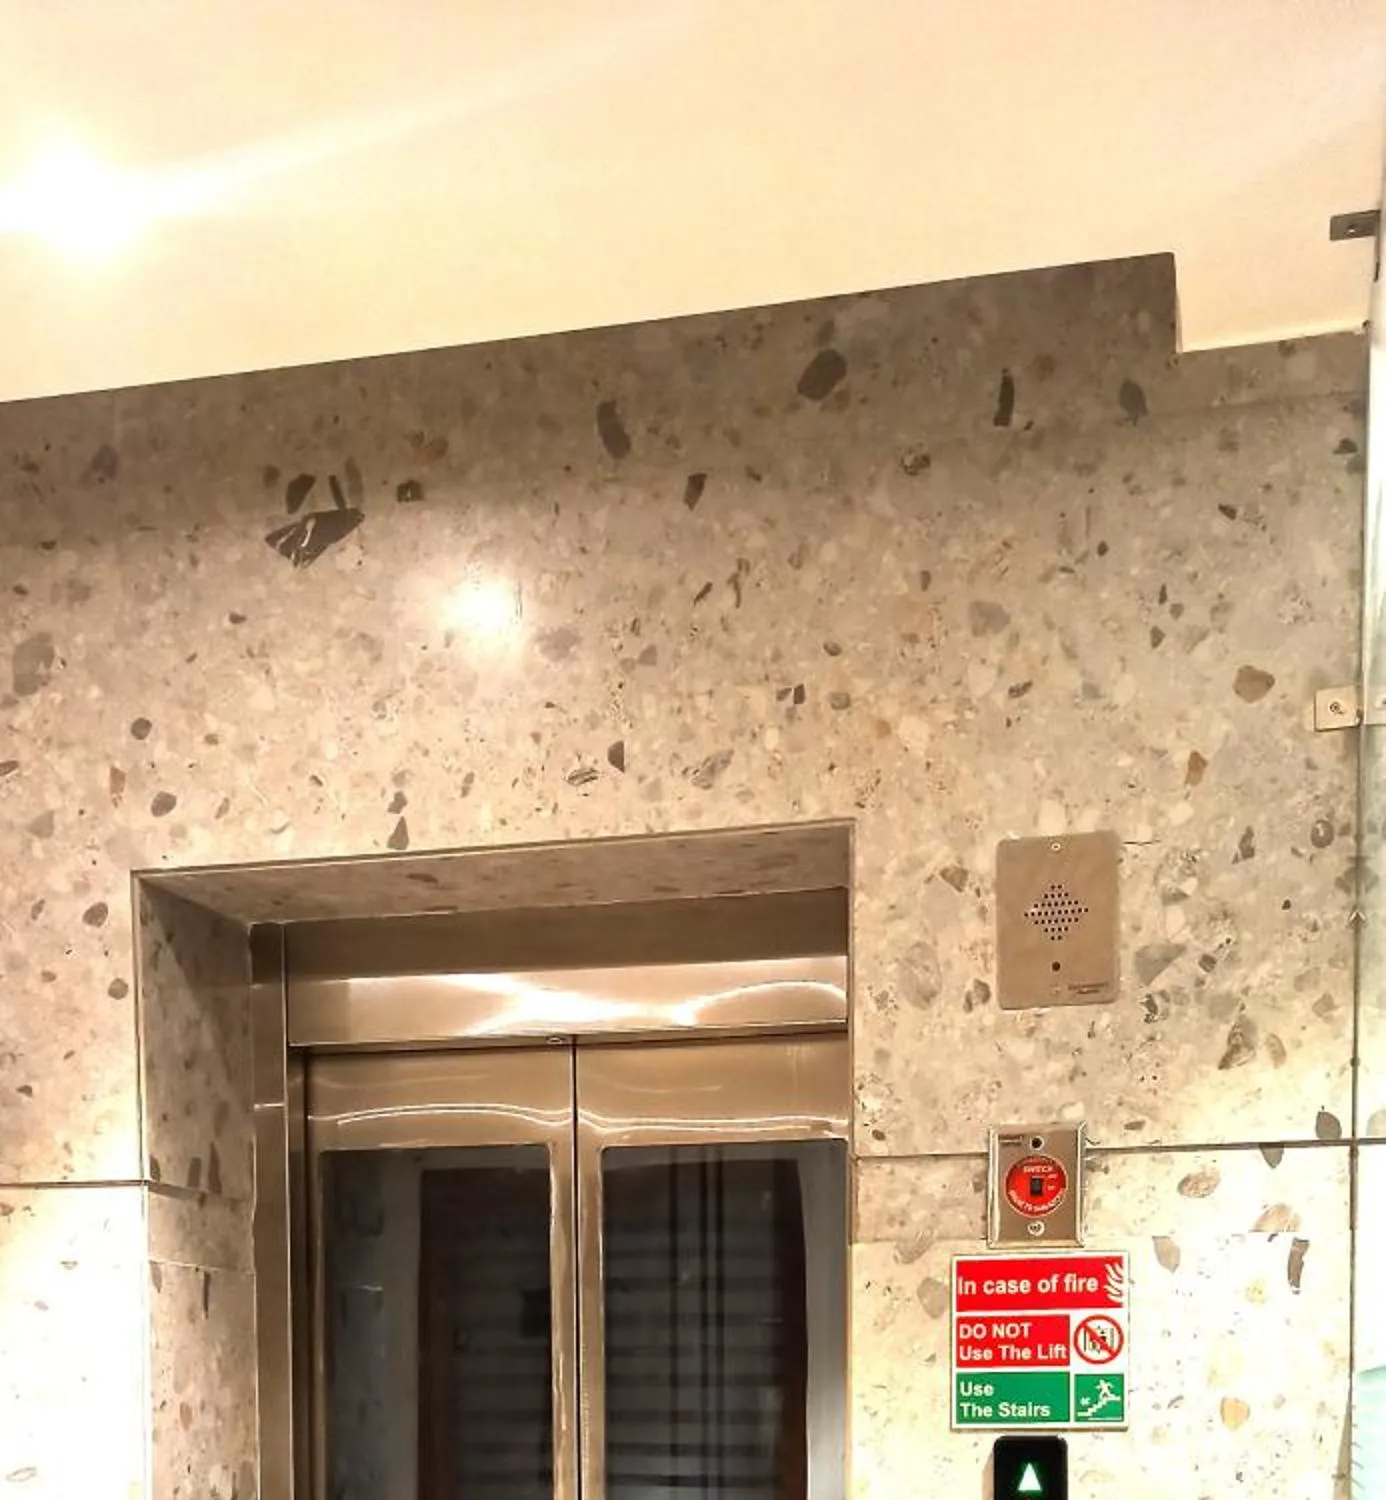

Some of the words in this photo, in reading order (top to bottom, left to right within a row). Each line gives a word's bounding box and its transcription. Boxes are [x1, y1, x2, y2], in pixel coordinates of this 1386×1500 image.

[957, 1276, 976, 1295] In
[983, 1279, 1031, 1295] case
[1037, 1274, 1059, 1293] of
[1064, 1274, 1098, 1292] fire
[959, 1324, 987, 1340] DO
[992, 1322, 1032, 1338] NOT
[959, 1346, 993, 1361] Use
[998, 1345, 1032, 1361] The
[1037, 1344, 1068, 1360] Lift
[959, 1381, 994, 1397] Use
[960, 1403, 993, 1417] The
[998, 1401, 1050, 1418] Stairs
